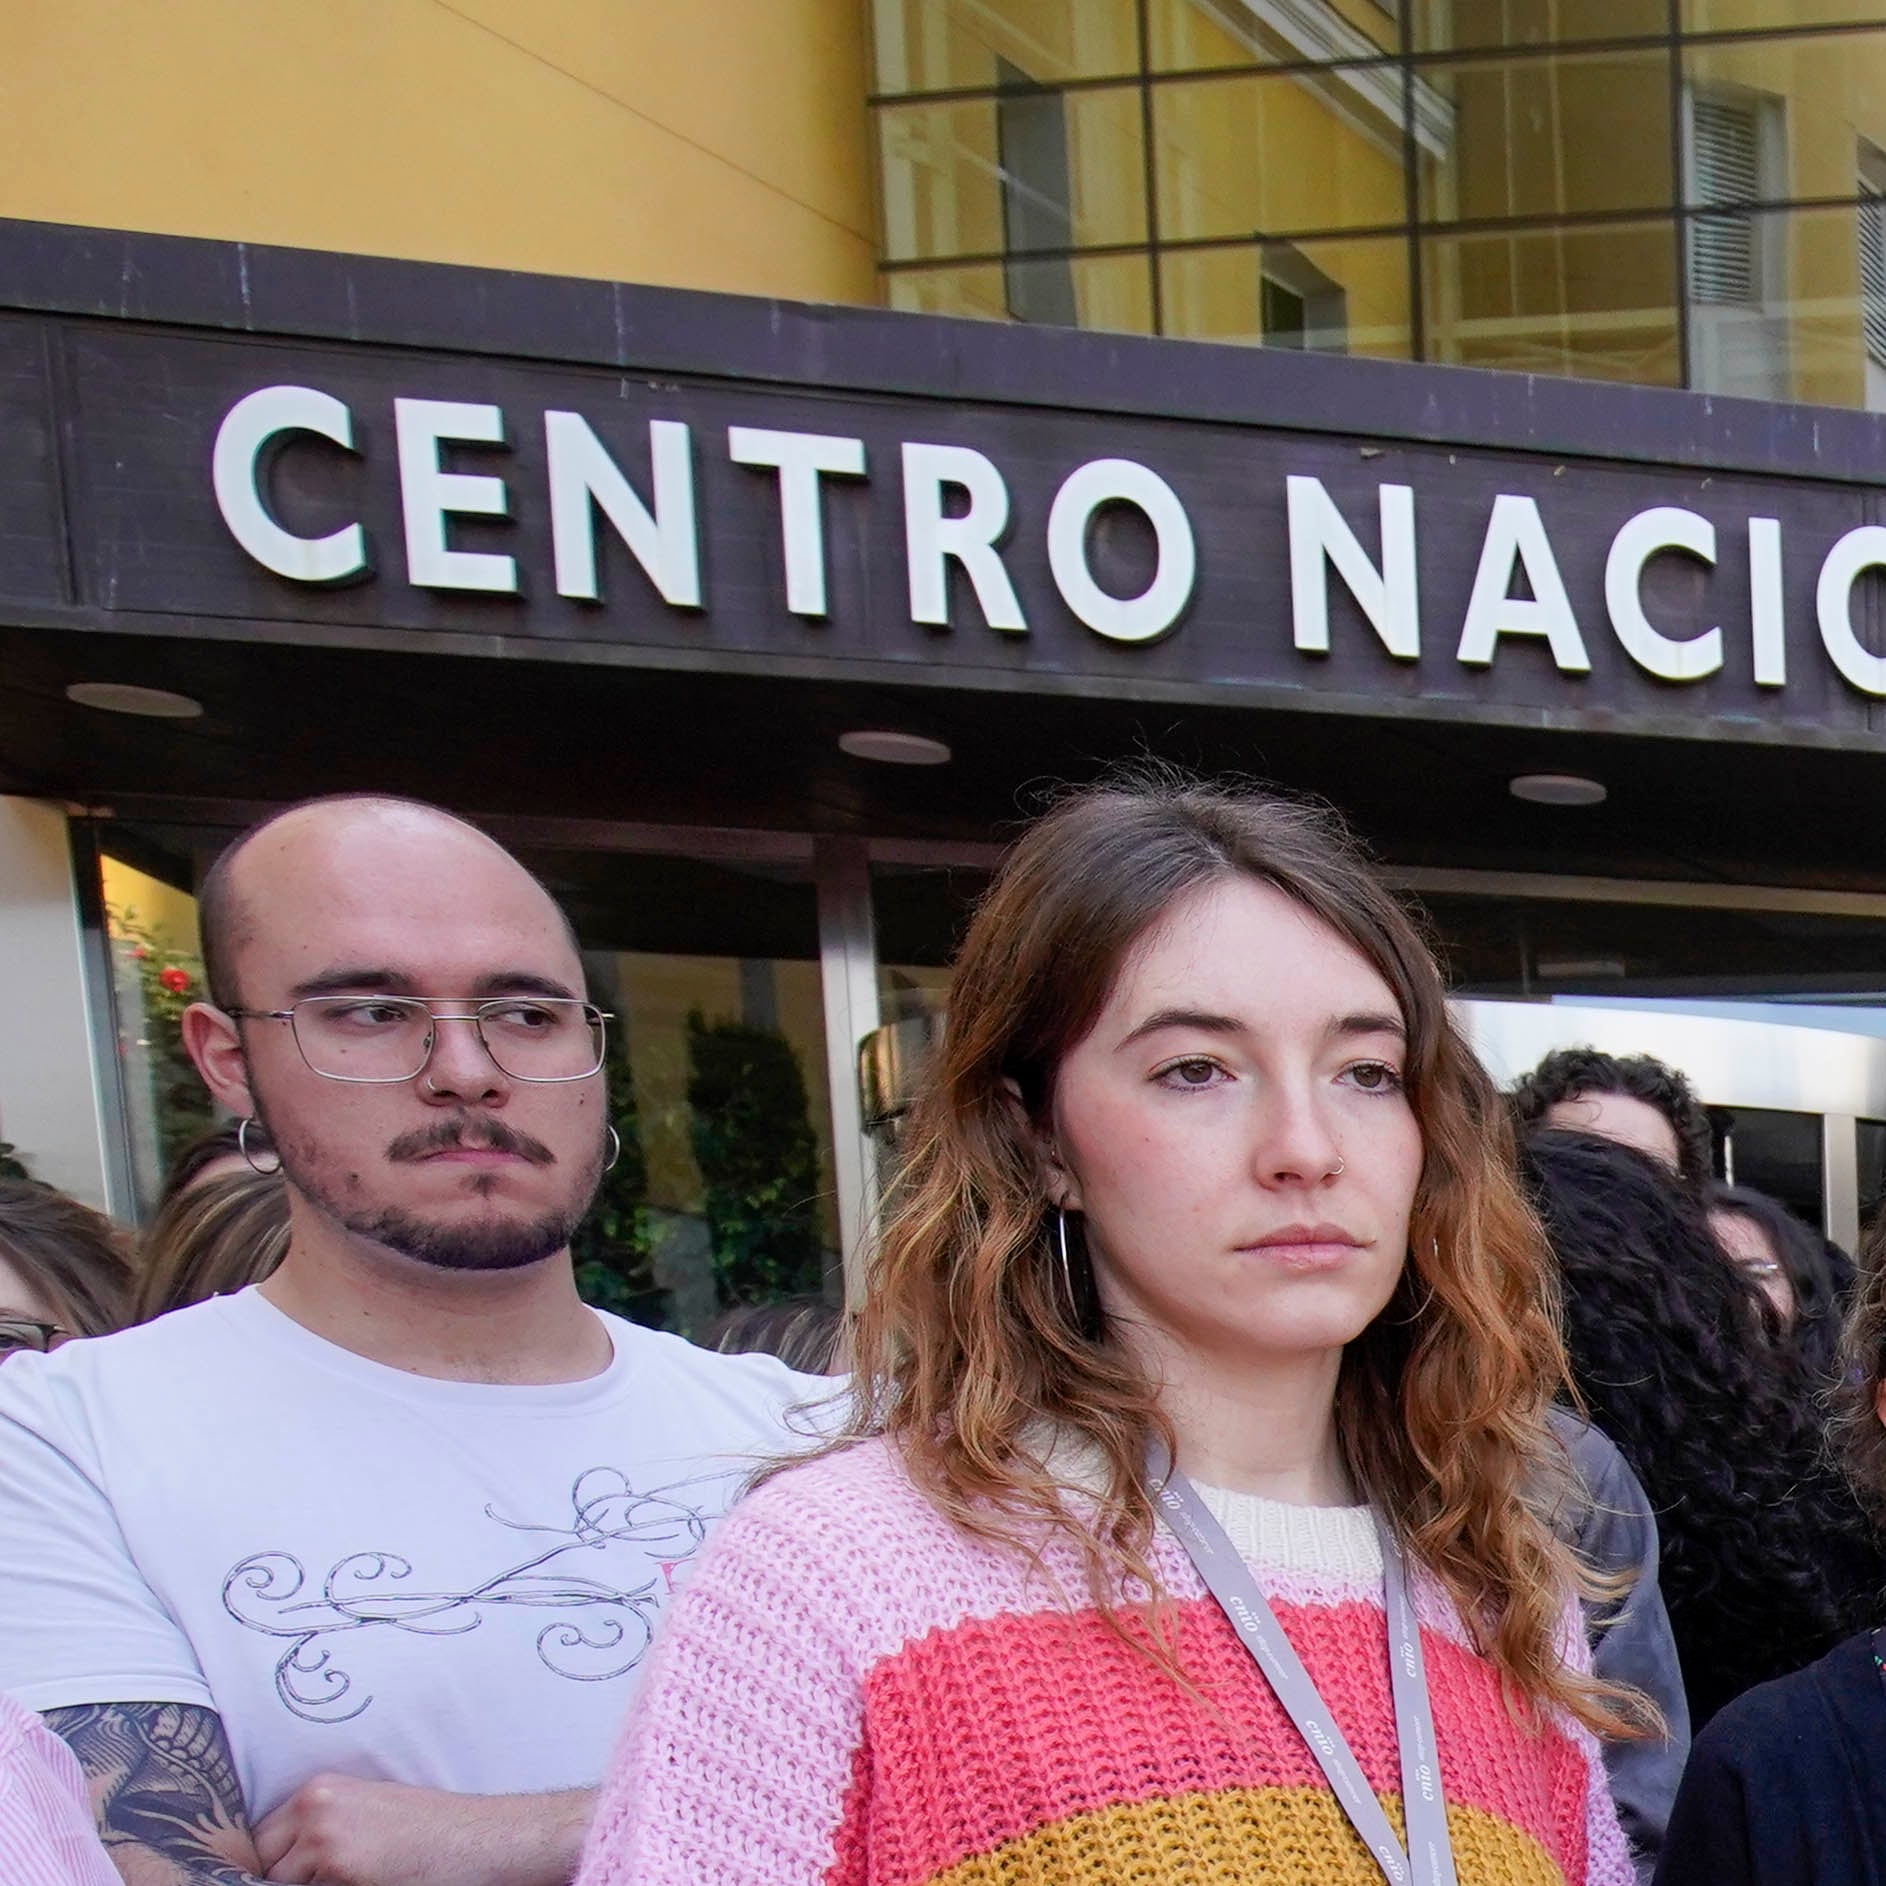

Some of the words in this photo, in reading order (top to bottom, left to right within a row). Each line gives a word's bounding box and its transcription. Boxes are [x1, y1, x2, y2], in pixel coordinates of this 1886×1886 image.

[212, 384, 1198, 641] CENTRO
[1229, 1596, 1261, 1633] cnio
[1400, 1642, 1417, 1678] cnio
[1305, 1719, 1336, 1756] cnio
[1415, 1764, 1434, 1801] cnio
